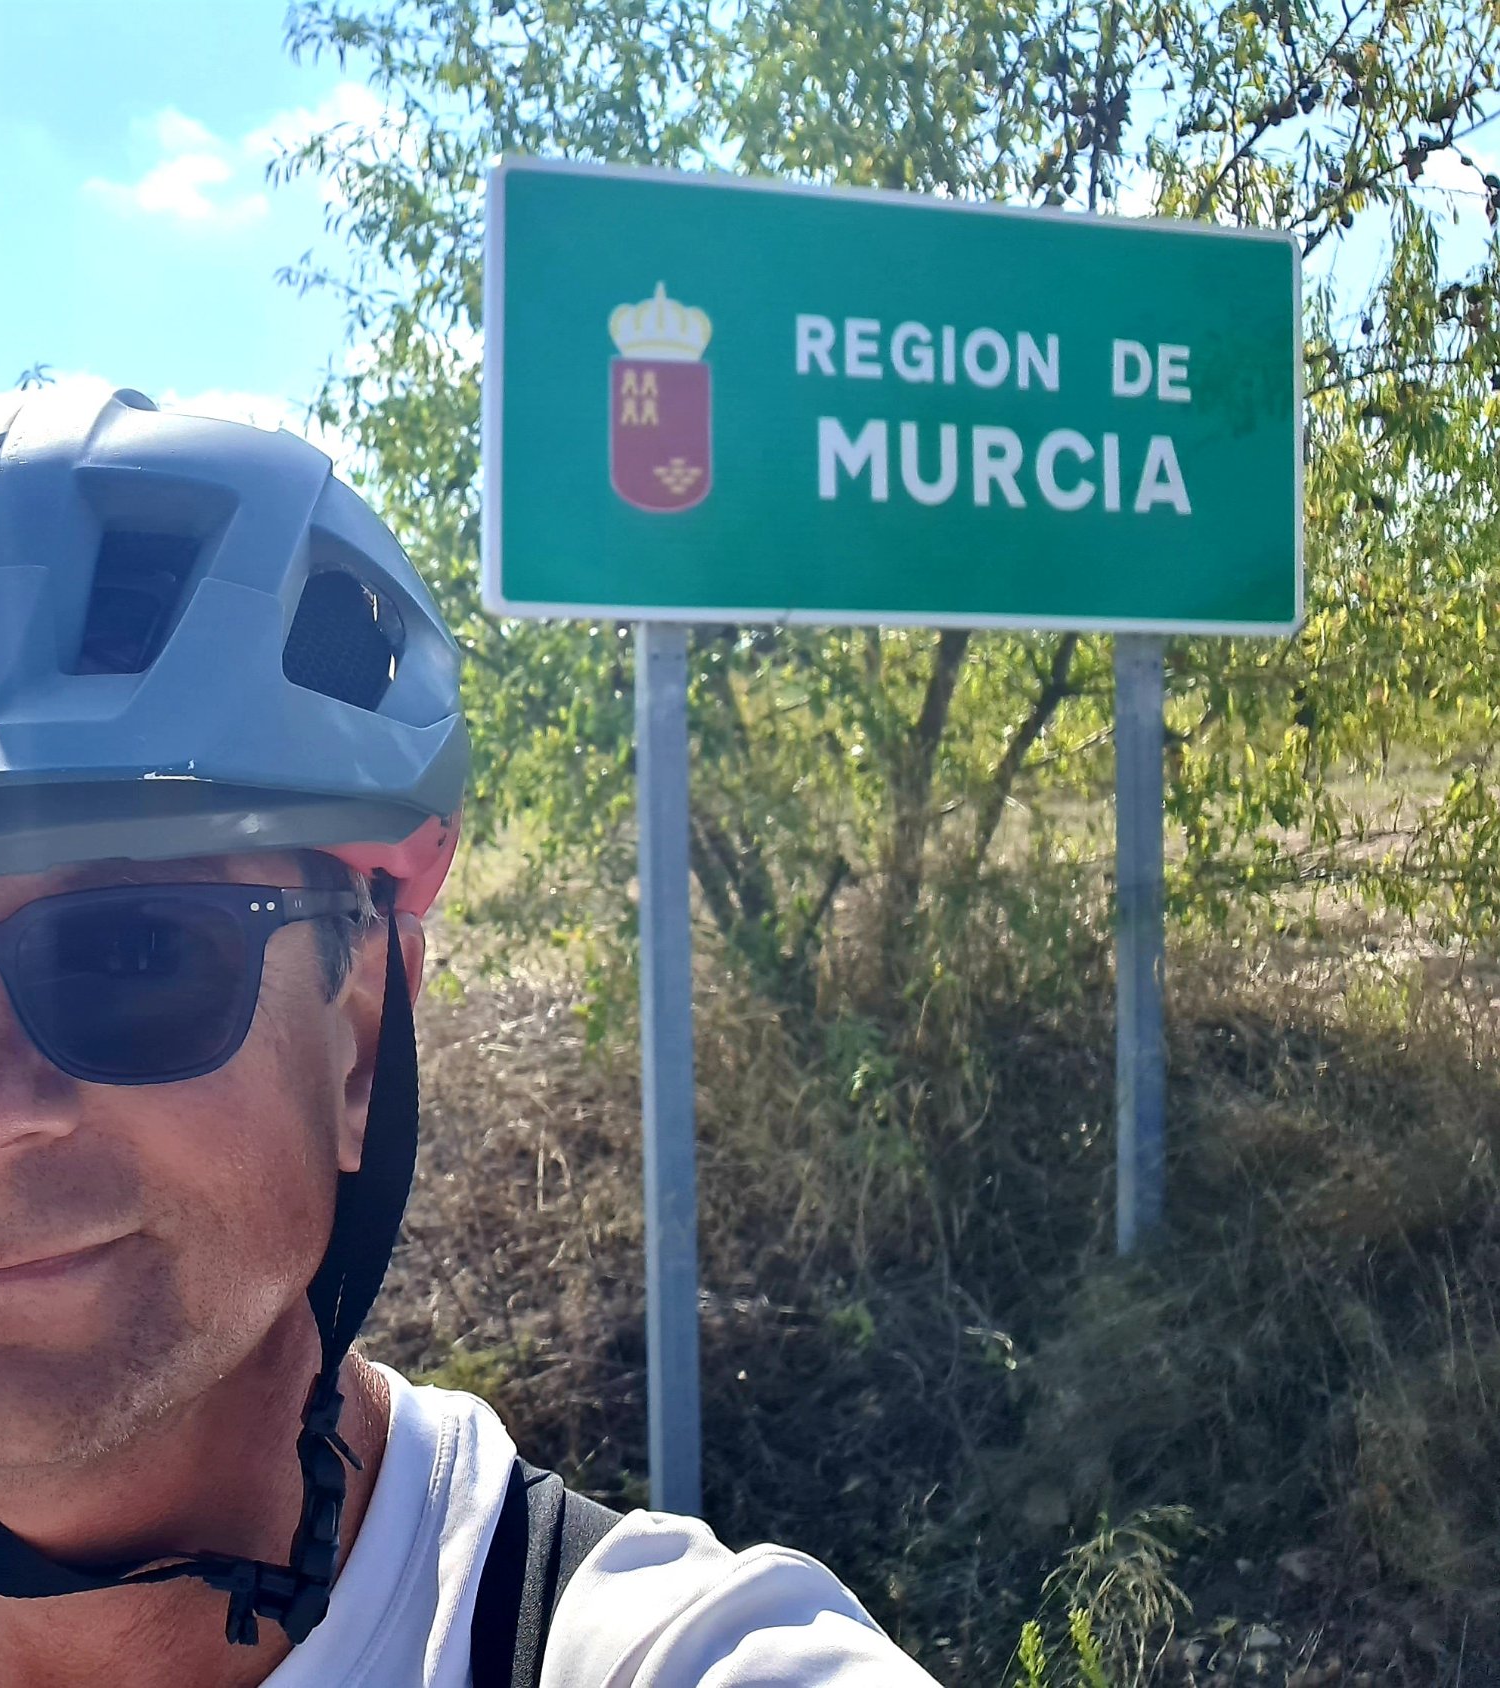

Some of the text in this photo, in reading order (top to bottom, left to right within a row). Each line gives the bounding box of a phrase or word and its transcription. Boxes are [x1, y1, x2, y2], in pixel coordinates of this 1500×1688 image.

[796, 314, 1193, 402] REGION DE
[817, 416, 1193, 515] MURCIA
